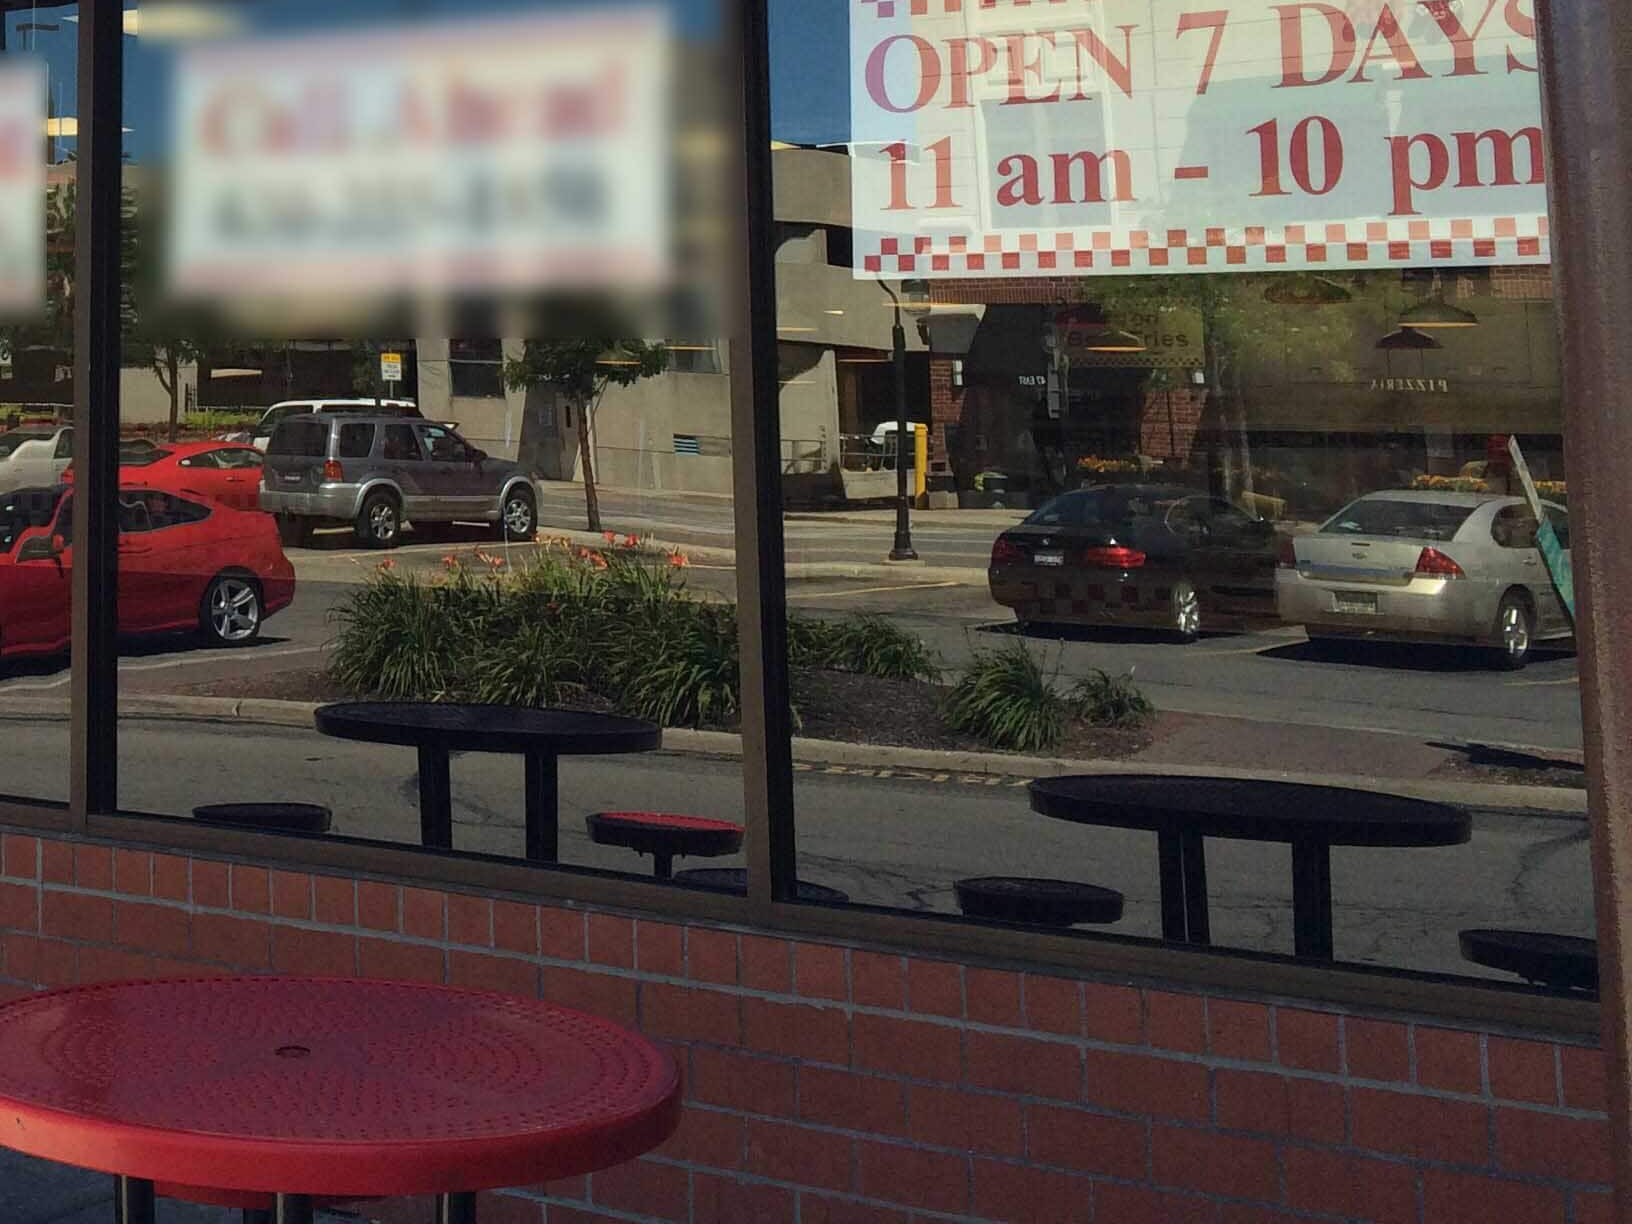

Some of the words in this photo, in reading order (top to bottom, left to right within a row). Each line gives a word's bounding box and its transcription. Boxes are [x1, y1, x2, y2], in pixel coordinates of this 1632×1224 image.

[865, 24, 1141, 114] OPEN
[1176, 10, 1230, 95] 7
[879, 135, 962, 211] 11
[996, 149, 1138, 208] am
[1245, 115, 1344, 197] 10
[1384, 127, 1545, 216] pm
